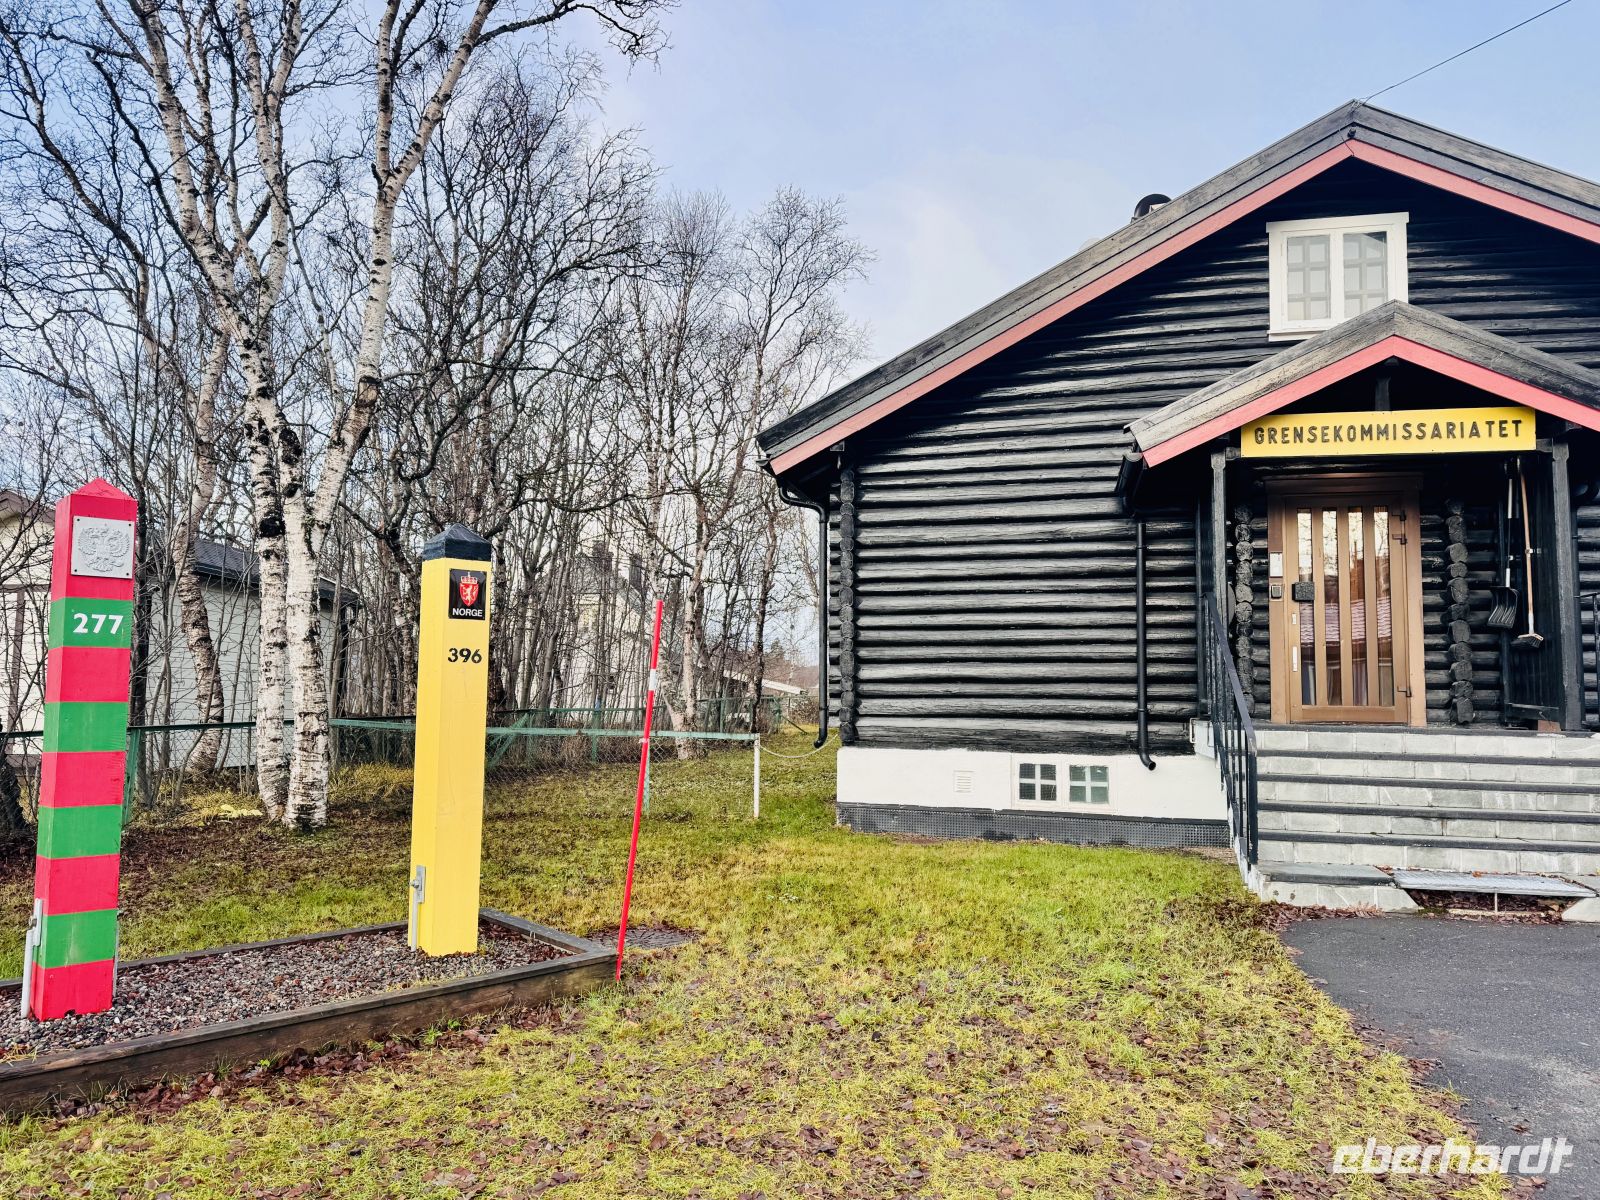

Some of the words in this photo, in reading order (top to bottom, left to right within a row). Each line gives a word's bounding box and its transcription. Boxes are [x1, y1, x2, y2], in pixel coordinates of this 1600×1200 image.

[1254, 419, 1523, 445] GRENSEKOMMISSARIATET
[452, 607, 483, 617] NORGE
[72, 612, 124, 635] 277
[447, 647, 482, 664] 396
